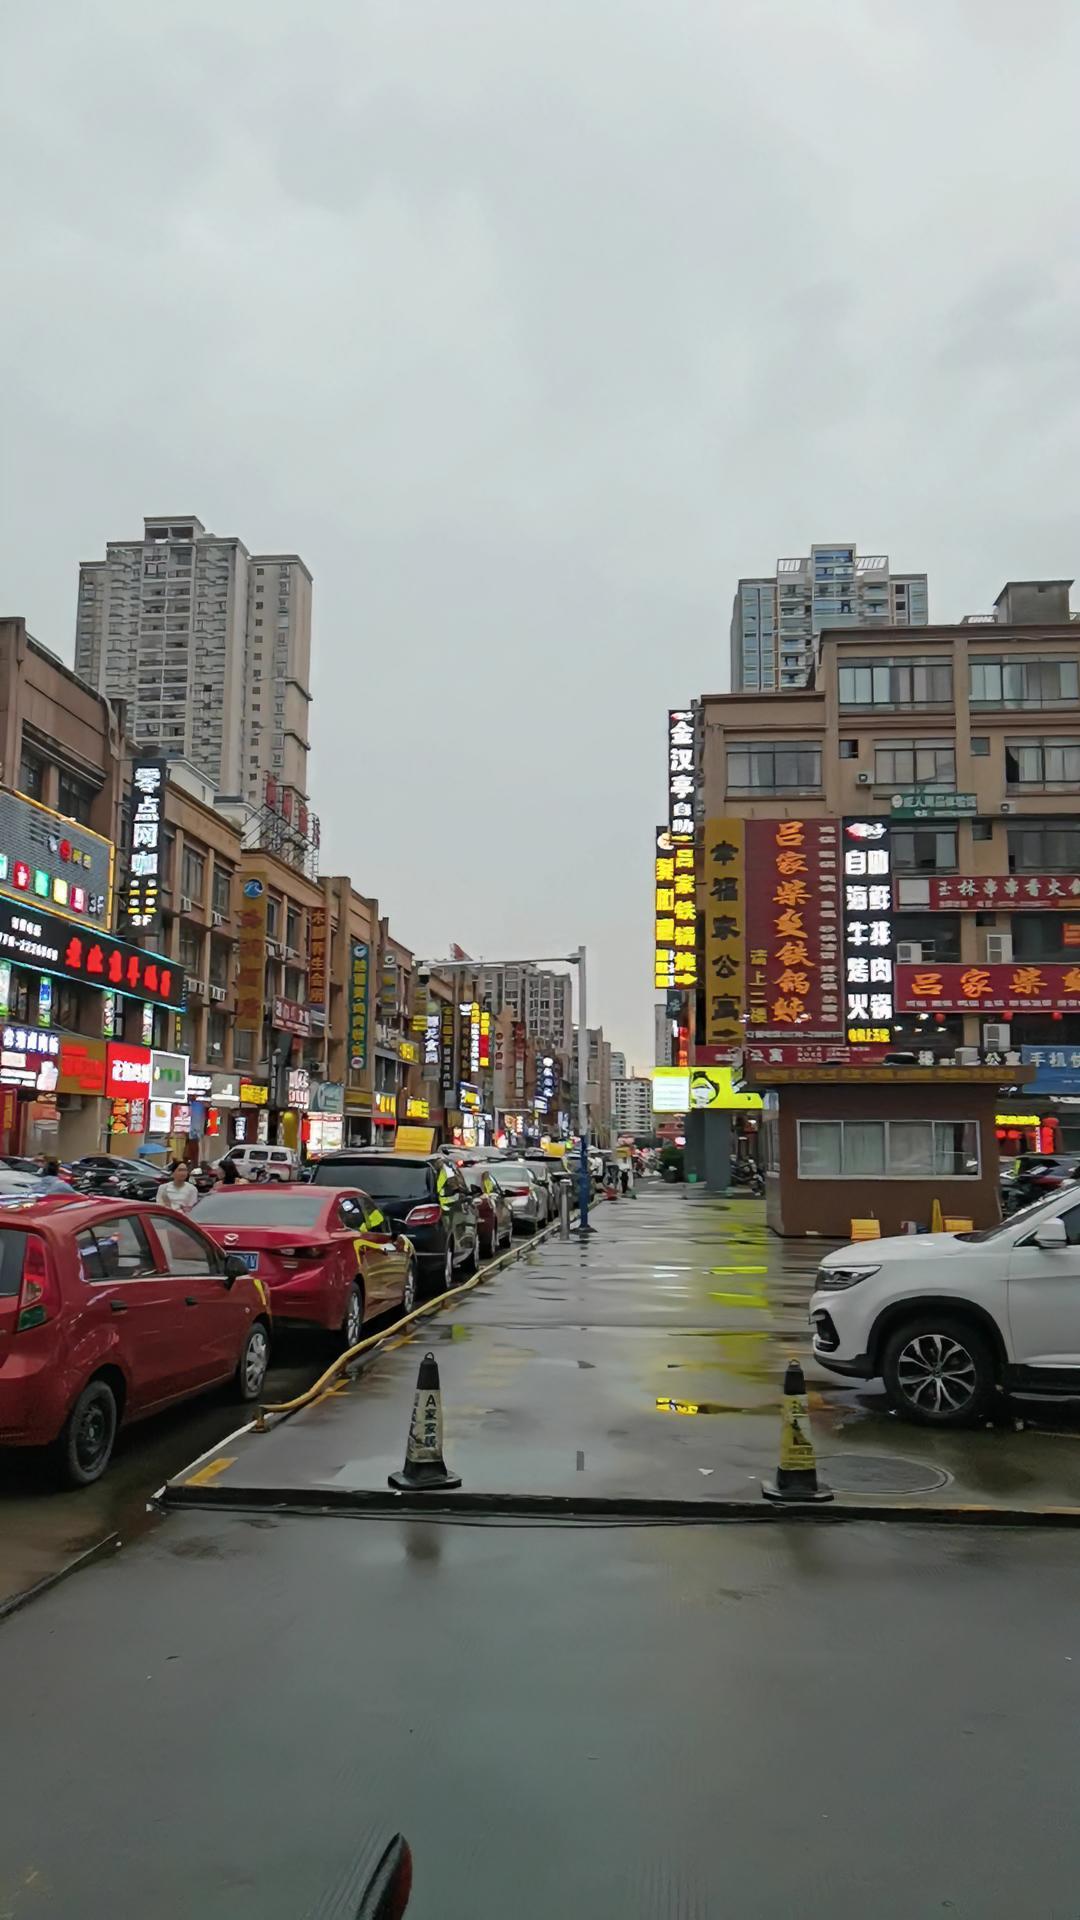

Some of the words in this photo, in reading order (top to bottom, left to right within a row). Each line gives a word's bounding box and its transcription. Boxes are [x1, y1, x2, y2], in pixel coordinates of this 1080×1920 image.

[130, 767, 161, 876] 零点网咖
[846, 885, 890, 911] 海鲜
[131, 915, 153, 927] 3F
[709, 839, 740, 1023] 幸福家公寓
[847, 921, 890, 946] 牛排
[847, 957, 892, 983] 烤肉
[847, 993, 893, 1021] 火锅
